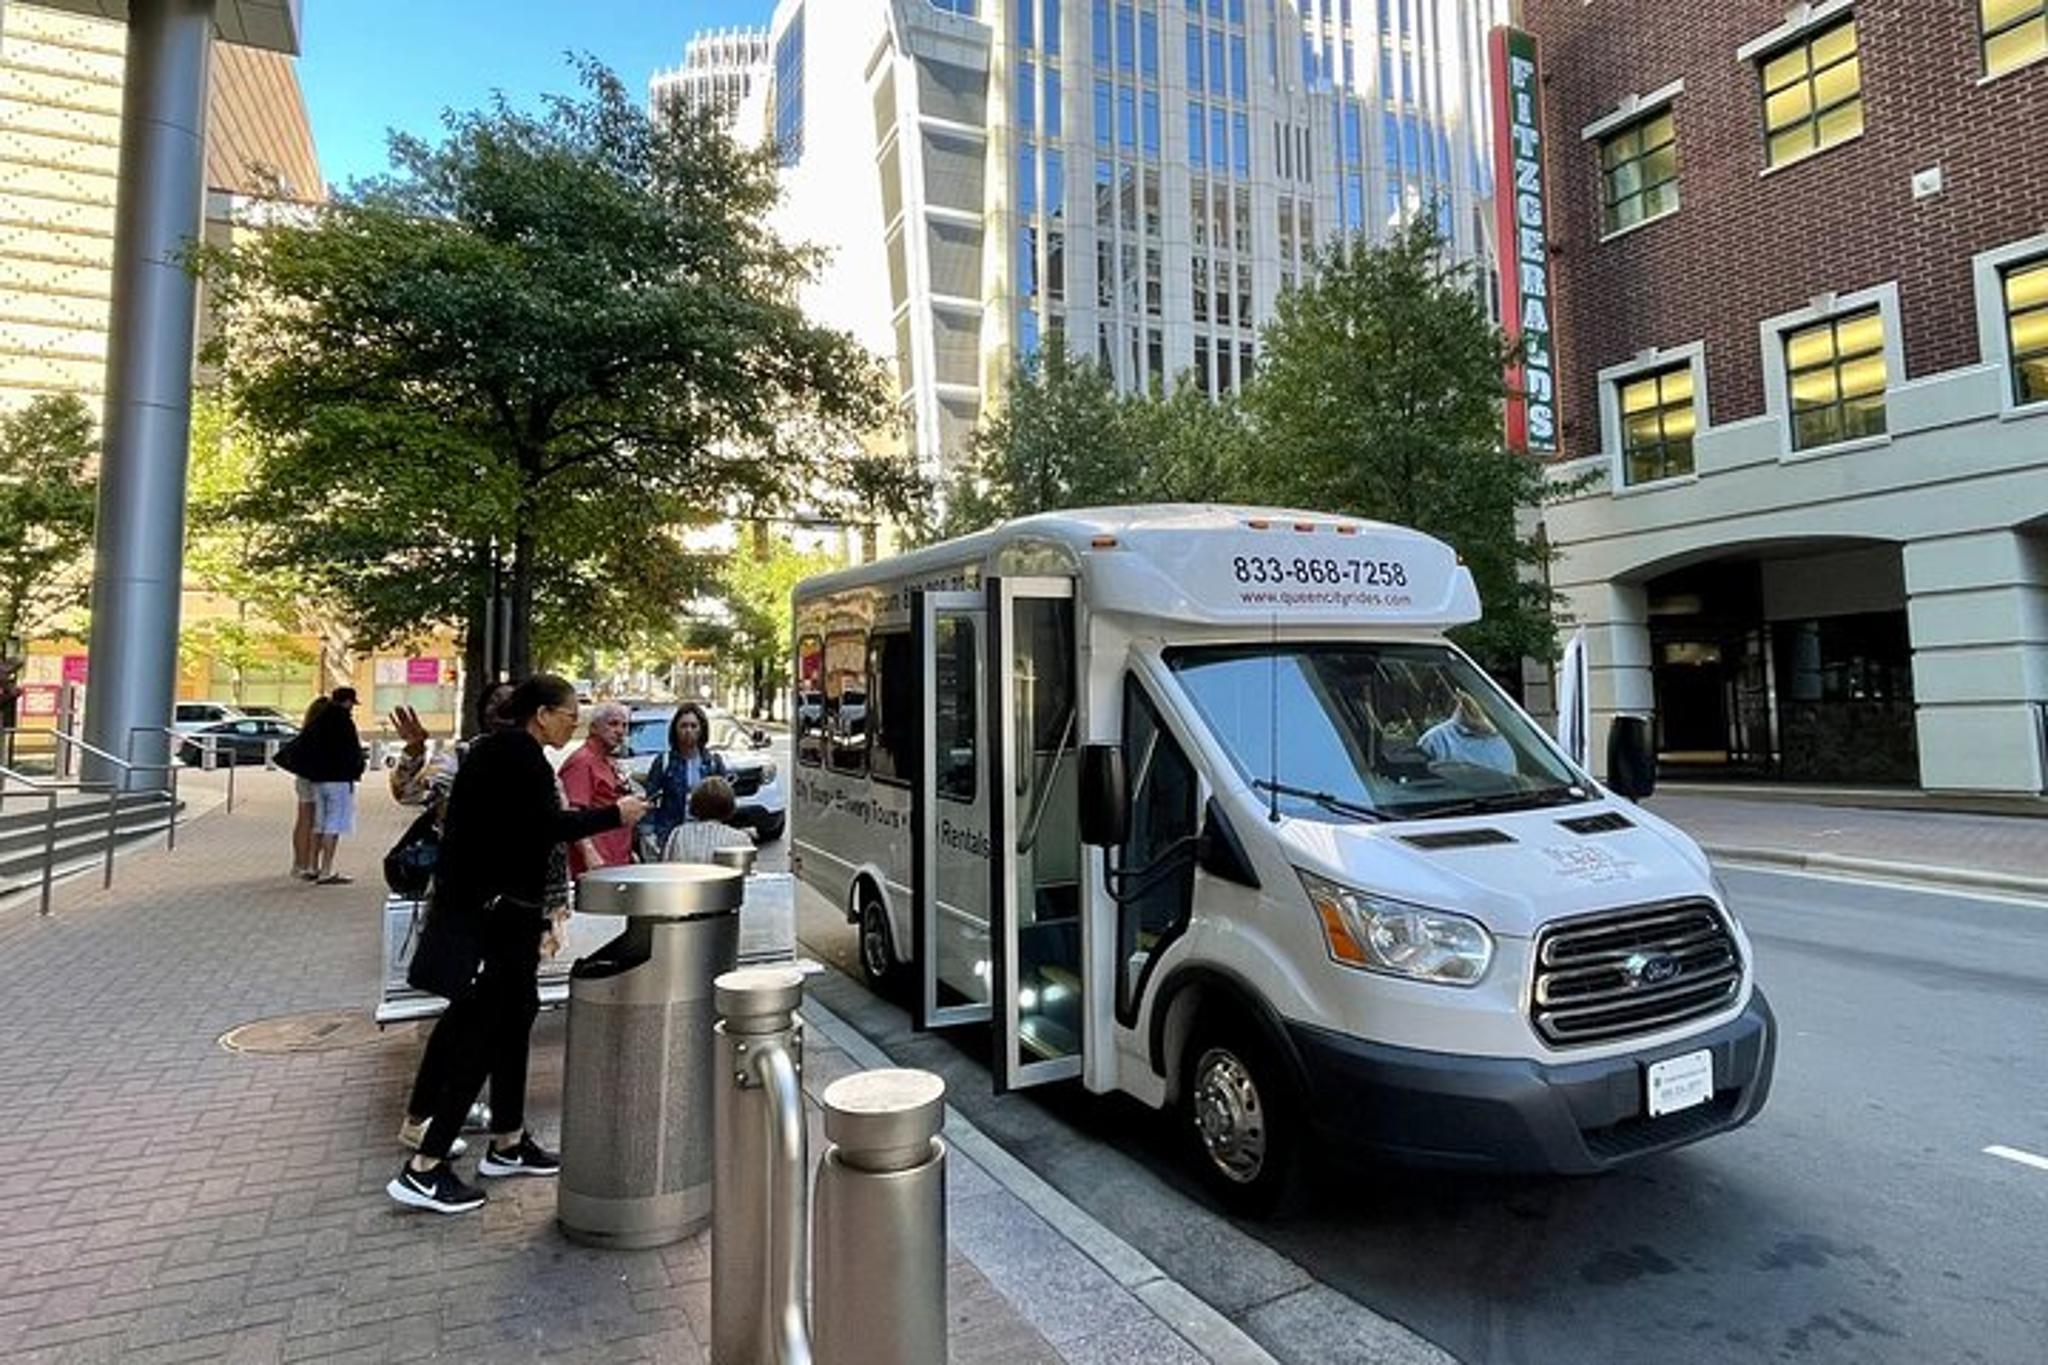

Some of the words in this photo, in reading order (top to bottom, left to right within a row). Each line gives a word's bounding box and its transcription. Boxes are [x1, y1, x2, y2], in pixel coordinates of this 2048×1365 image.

[1512, 56, 1554, 438] FITZGERALDS
[1233, 556, 1408, 587] 833-868-7258
[1240, 591, 1411, 607] www.queencityrides.com
[941, 819, 989, 860] Rentals
